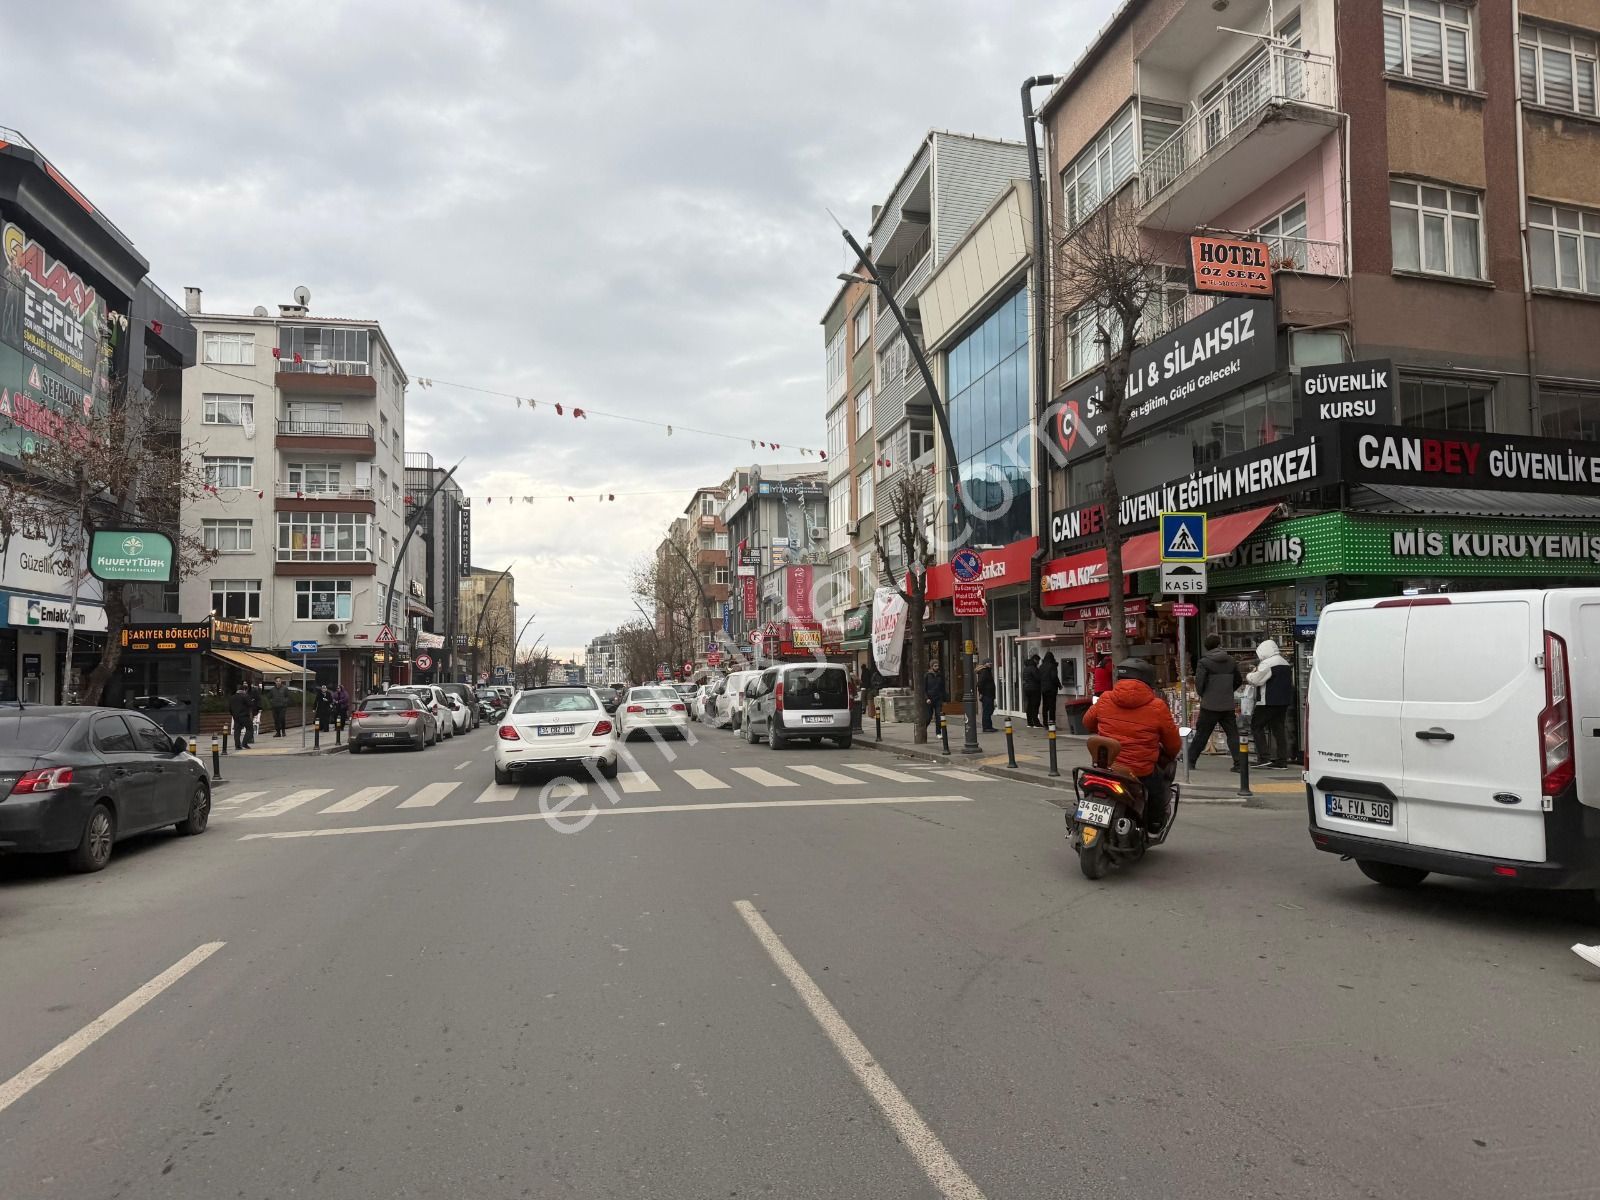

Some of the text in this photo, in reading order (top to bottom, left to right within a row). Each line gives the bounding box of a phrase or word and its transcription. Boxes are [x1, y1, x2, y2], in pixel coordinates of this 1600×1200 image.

[1199, 242, 1266, 268] HOTEL
[3, 221, 96, 322] GALAXY
[1200, 264, 1267, 281] ÖZ SEFA
[24, 286, 84, 351] E-SPOR
[1147, 361, 1160, 387] &
[1163, 309, 1255, 380] SİLAHSIZ
[1139, 396, 1168, 420] Eğitim,
[1169, 378, 1195, 402] Güçlü
[1197, 358, 1241, 388] Gelecek!
[1304, 368, 1388, 396] GÜVENLİK
[1319, 399, 1377, 420] KURSU
[1358, 434, 1481, 475] CANBEY
[1489, 444, 1587, 483] GÜVENLİK
[1179, 467, 1232, 510] EĞİTİM
[1235, 436, 1318, 497] MERKEZİ
[1393, 527, 1600, 564] MİS KURUYEMİŞ
[19, 552, 54, 576] Güzellik
[1165, 578, 1204, 591] KASİS
[129, 629, 163, 640] SARIYER
[165, 627, 210, 641] BÖREKÇİSİ
[1079, 801, 1112, 816] 34 GUK
[1088, 812, 1104, 823] 216
[1332, 798, 1344, 812] 34
[1348, 800, 1366, 816] FVA
[1371, 803, 1390, 818] 506
